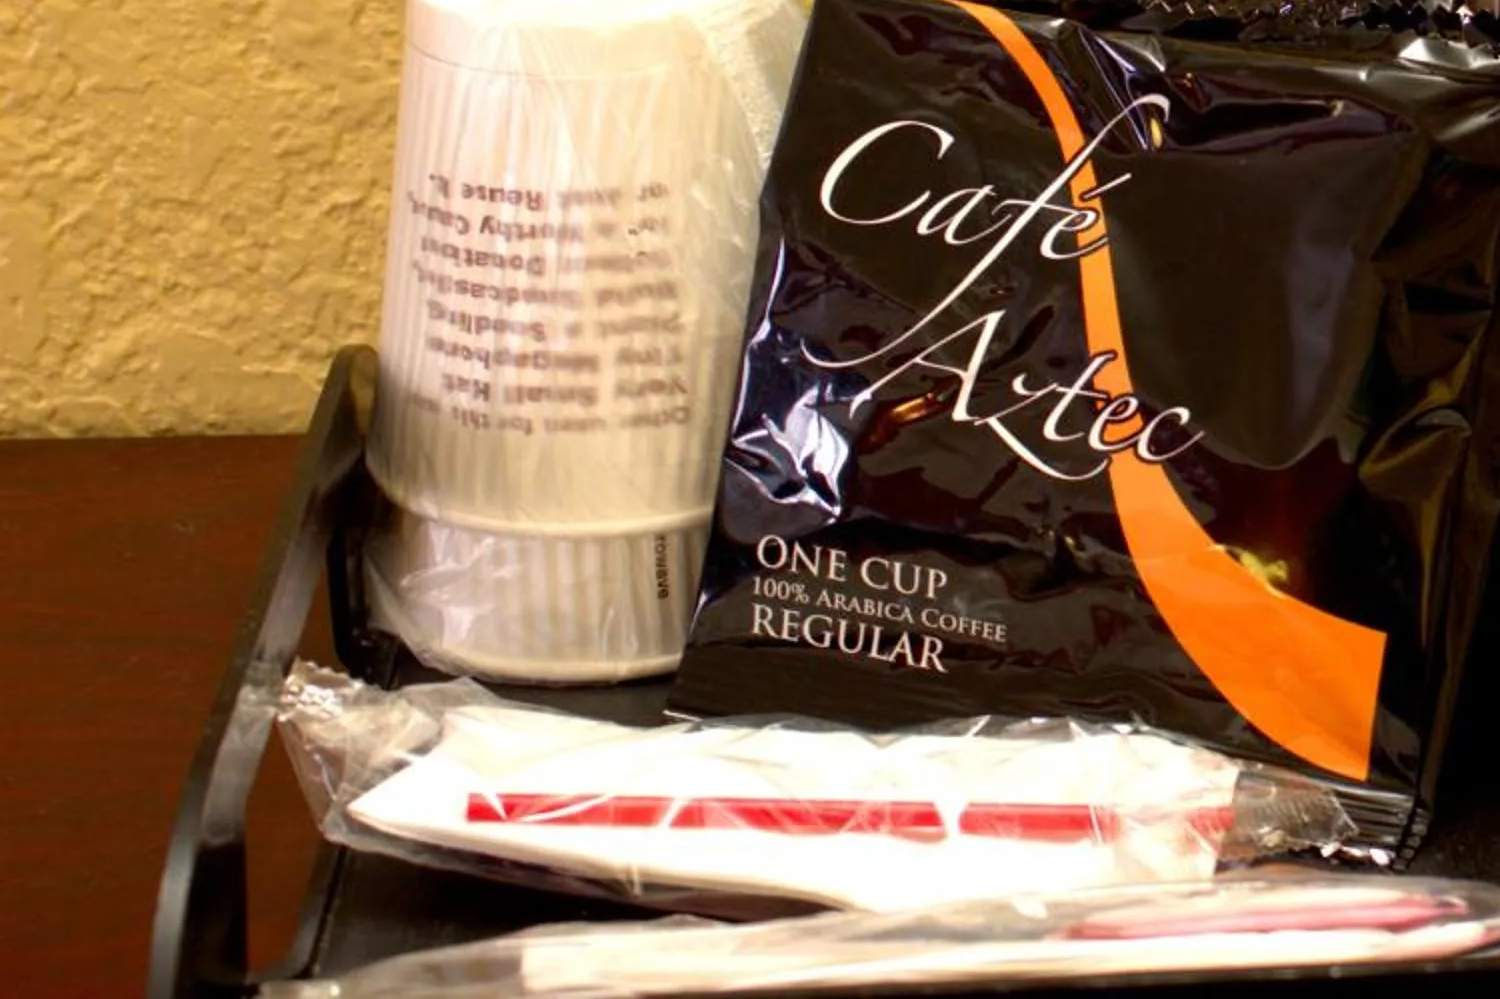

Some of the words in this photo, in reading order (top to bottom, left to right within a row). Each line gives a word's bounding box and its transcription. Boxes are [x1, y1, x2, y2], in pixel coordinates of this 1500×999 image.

[461, 183, 543, 212] Reuse
[801, 94, 1169, 367] Café
[848, 310, 1204, 480] Aztec
[756, 533, 848, 582] ONE
[860, 555, 948, 599] CUP
[751, 602, 949, 674] REGULAR
[752, 575, 810, 604] 100%
[816, 589, 916, 625] ARABICA
[921, 607, 1008, 643] COFFEE
